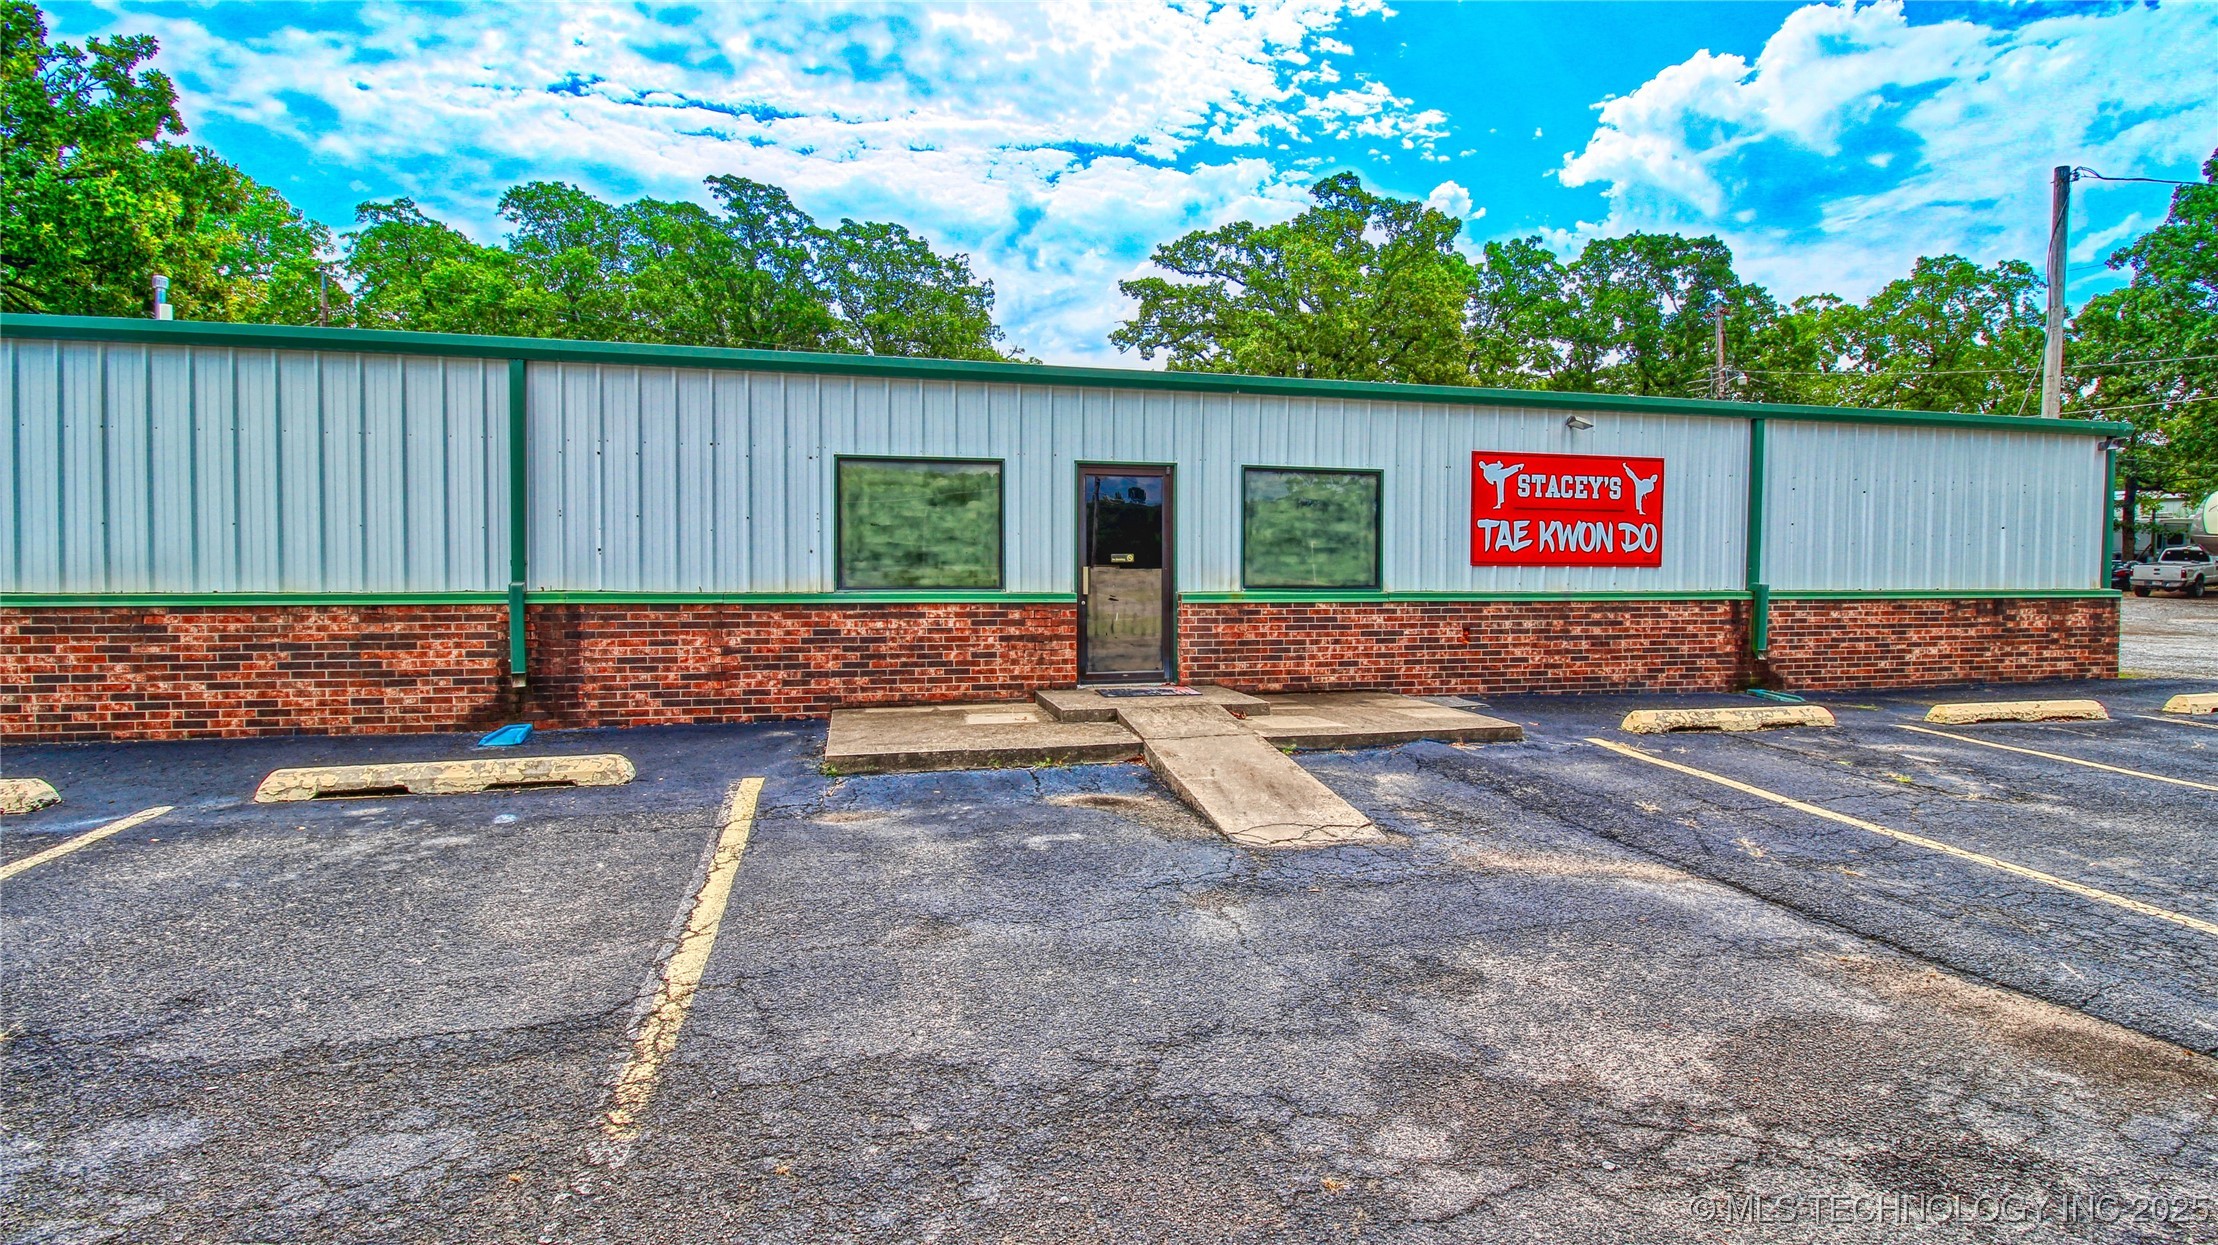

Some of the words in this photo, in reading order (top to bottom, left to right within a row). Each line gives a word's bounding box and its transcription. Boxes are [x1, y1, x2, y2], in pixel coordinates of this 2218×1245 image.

[1517, 473, 1622, 500] STACEY'S
[1477, 519, 1533, 553] TAE
[1539, 520, 1614, 553] KWON
[1617, 522, 1658, 554] DO
